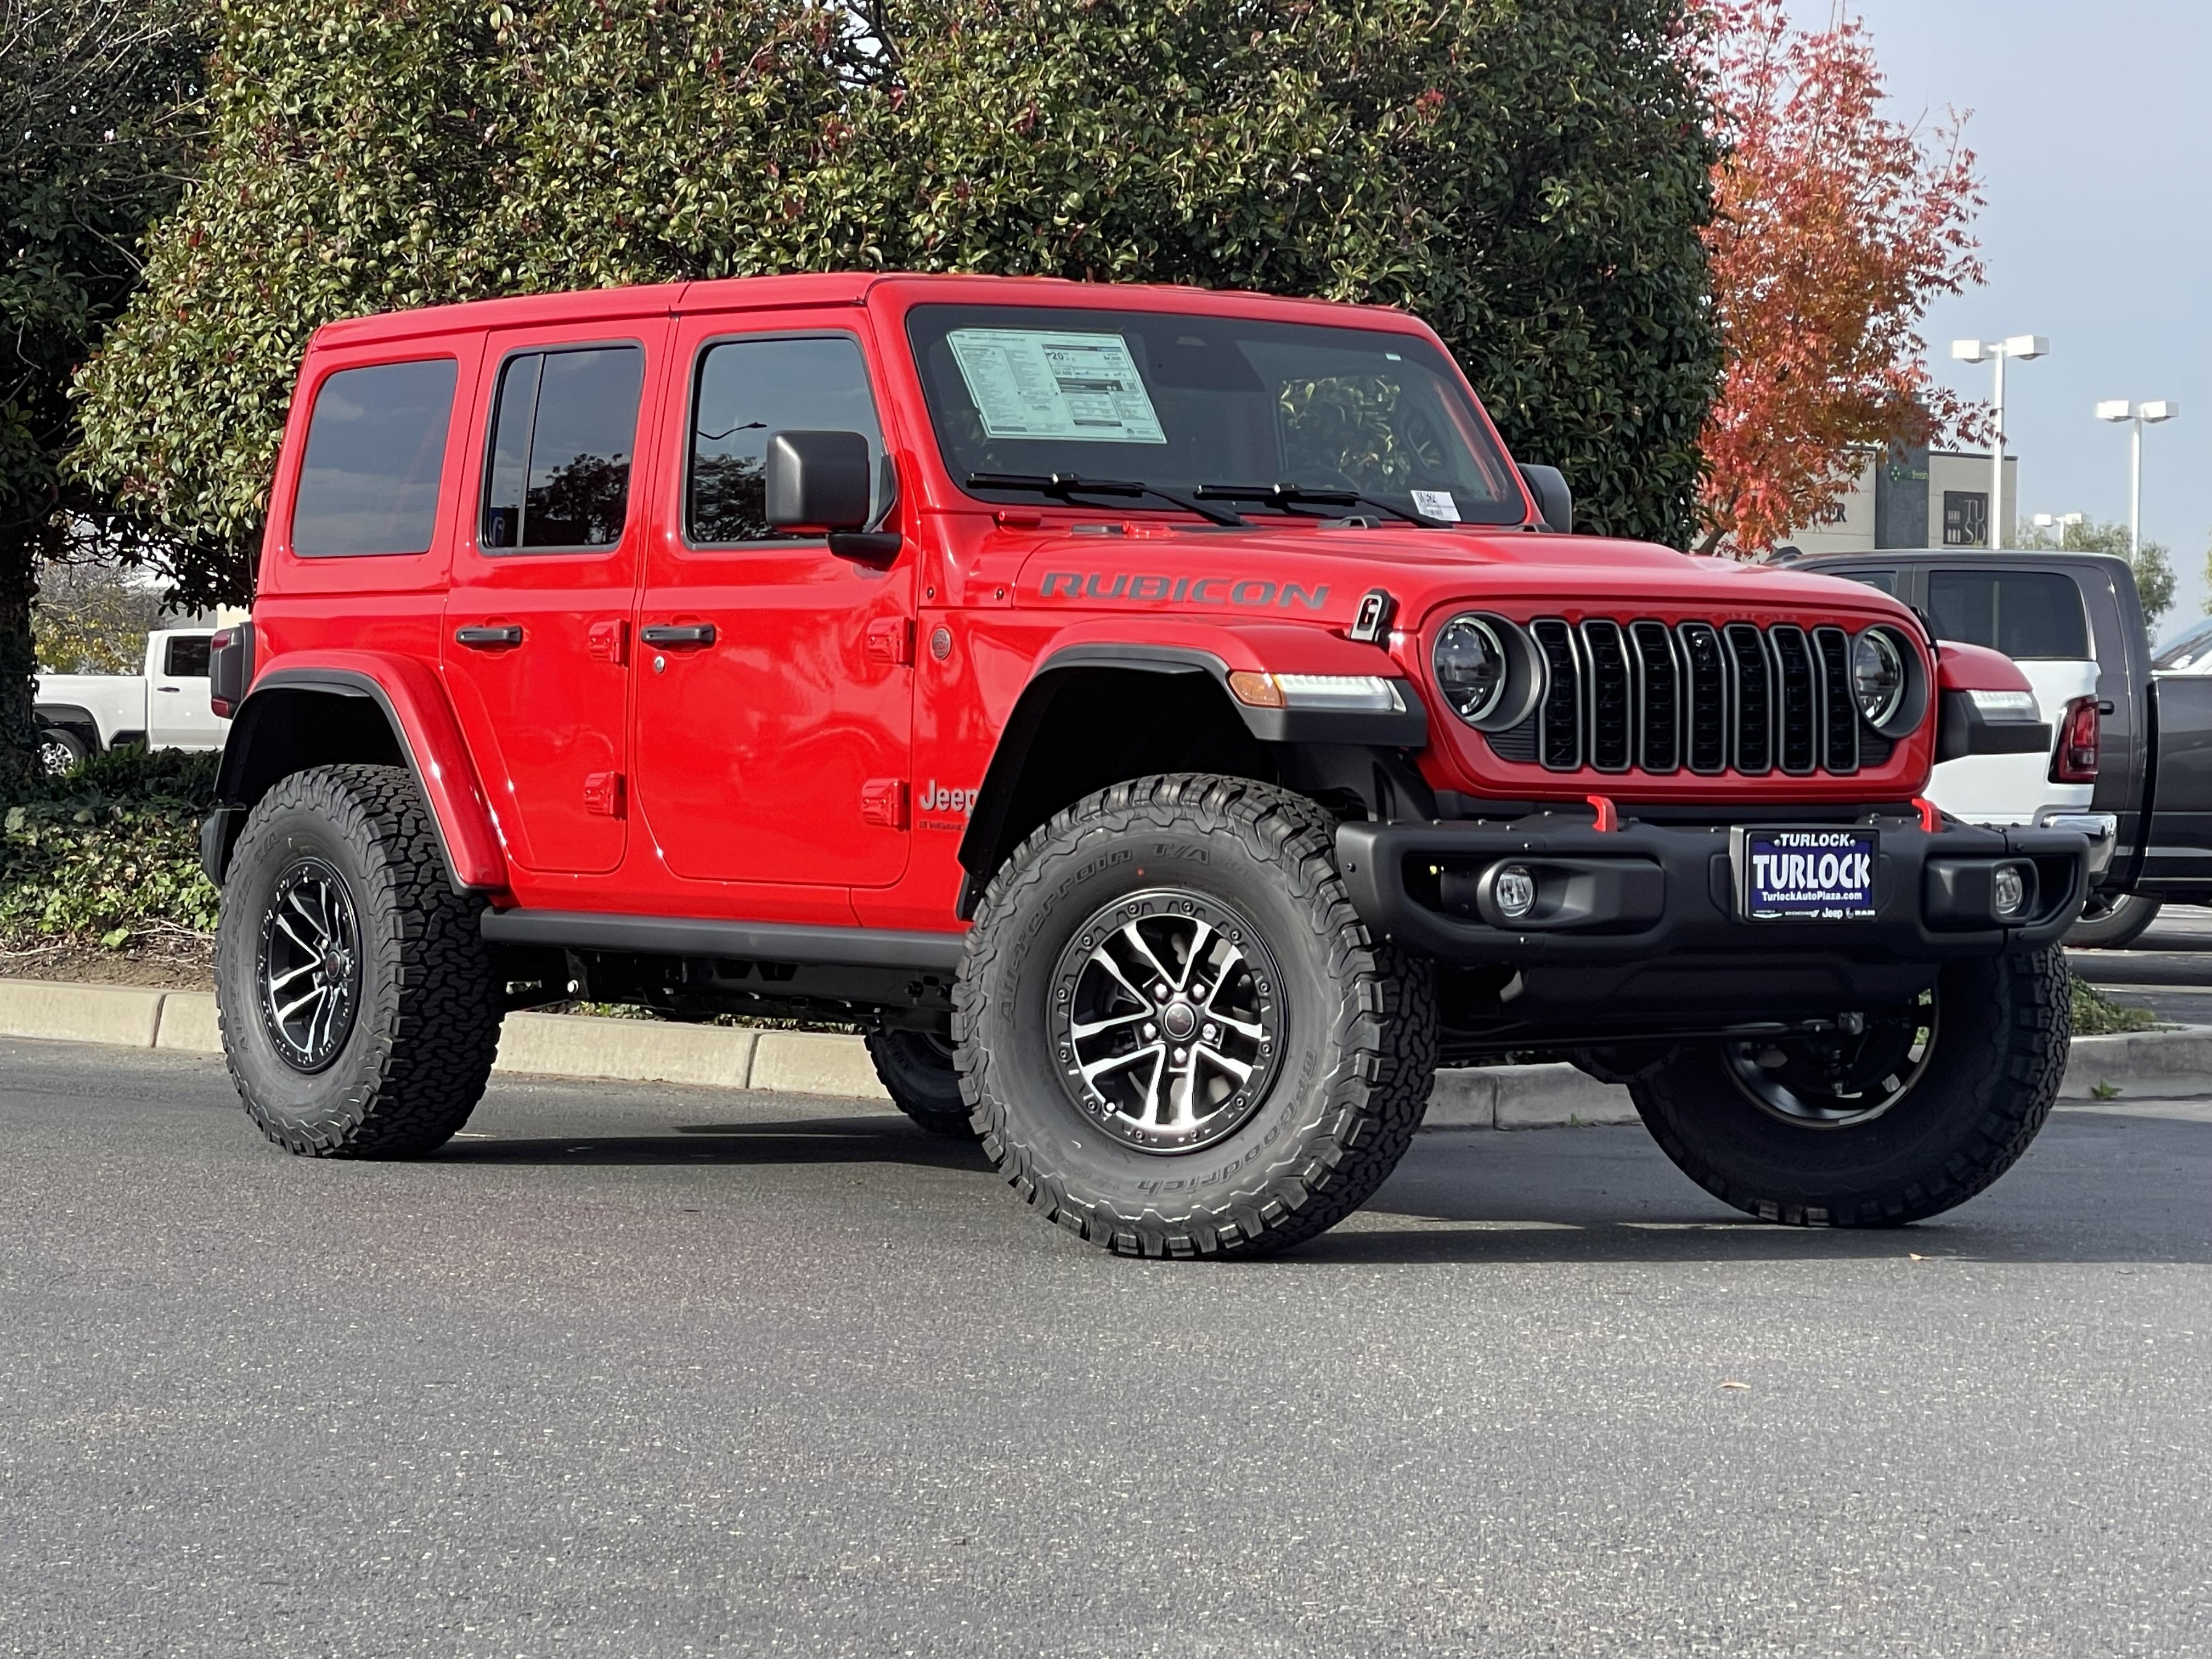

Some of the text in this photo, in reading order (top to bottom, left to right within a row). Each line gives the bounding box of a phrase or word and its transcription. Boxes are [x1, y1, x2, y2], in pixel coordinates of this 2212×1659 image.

[1040, 572, 1330, 610] RUBICON
[919, 779, 979, 817] Jeep
[1780, 833, 1850, 847] TURLOCK
[1753, 854, 1870, 889] TURLOCK
[1762, 891, 1862, 901] TurlockAutoPlaza.com
[1822, 907, 1843, 919] Jeep
[1000, 843, 1210, 1029] All-Terrain T/A
[1137, 1050, 1316, 1195] BFGoodrich
